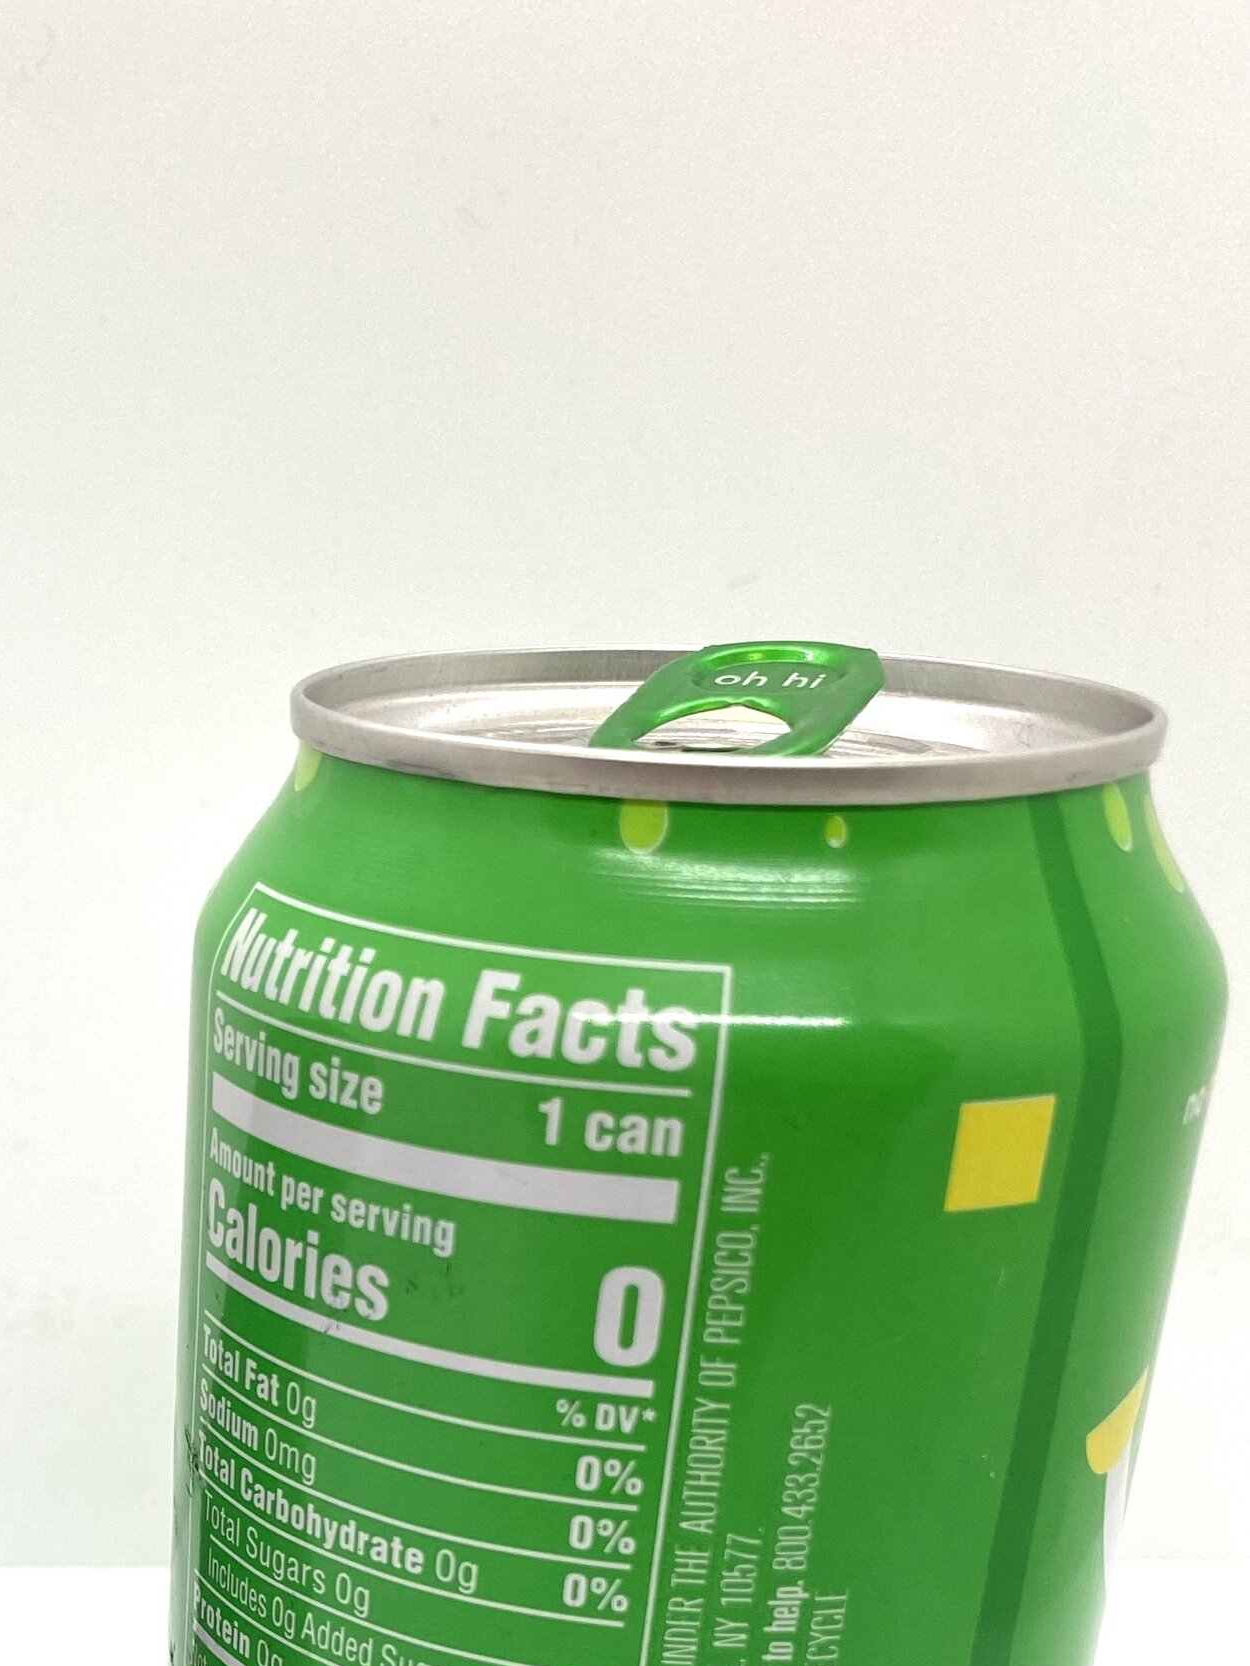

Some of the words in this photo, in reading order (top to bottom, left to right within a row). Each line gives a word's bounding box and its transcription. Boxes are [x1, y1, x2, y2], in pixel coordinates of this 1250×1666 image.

[714, 671, 768, 687] oh
[781, 672, 827, 689] hi
[220, 907, 446, 1042] Nutrition
[461, 969, 698, 1072] Facts
[212, 1006, 300, 1101] Serving
[309, 1056, 385, 1116] size
[538, 1097, 562, 1146] 1
[584, 1110, 684, 1158] can
[209, 1127, 276, 1197] Amount
[281, 1173, 324, 1223] per
[330, 1193, 457, 1258] serving
[207, 1177, 390, 1322] Calories
[703, 1224, 760, 1345] PEPSICO,
[593, 1265, 665, 1368] 0
[202, 1325, 240, 1382] Total
[245, 1362, 280, 1407] Fat
[285, 1381, 317, 1430] 0g
[698, 1355, 737, 1388] OF
[199, 1378, 259, 1452] Sodium
[264, 1427, 317, 1486] 0mg
[575, 1454, 645, 1497] 0%
[678, 1397, 731, 1535] AUTHORITY
[198, 1429, 235, 1486] Total
[240, 1467, 425, 1575] Carbohydrate
[434, 1548, 480, 1595] 0g
[568, 1514, 638, 1556] 0%
[772, 1404, 833, 1572] 800.433.2652
[204, 1490, 241, 1547] Total
[245, 1526, 327, 1595] Sugars
[335, 1571, 371, 1619] 0g
[207, 1548, 267, 1619] Includes
[271, 1595, 296, 1640] 0g
[562, 1572, 629, 1613] 0%
[670, 1544, 711, 1588] THE
[193, 1582, 251, 1660] Protein
[712, 1616, 749, 1650] NY
[761, 1640, 795, 1661] to
[763, 1578, 810, 1633] help.
